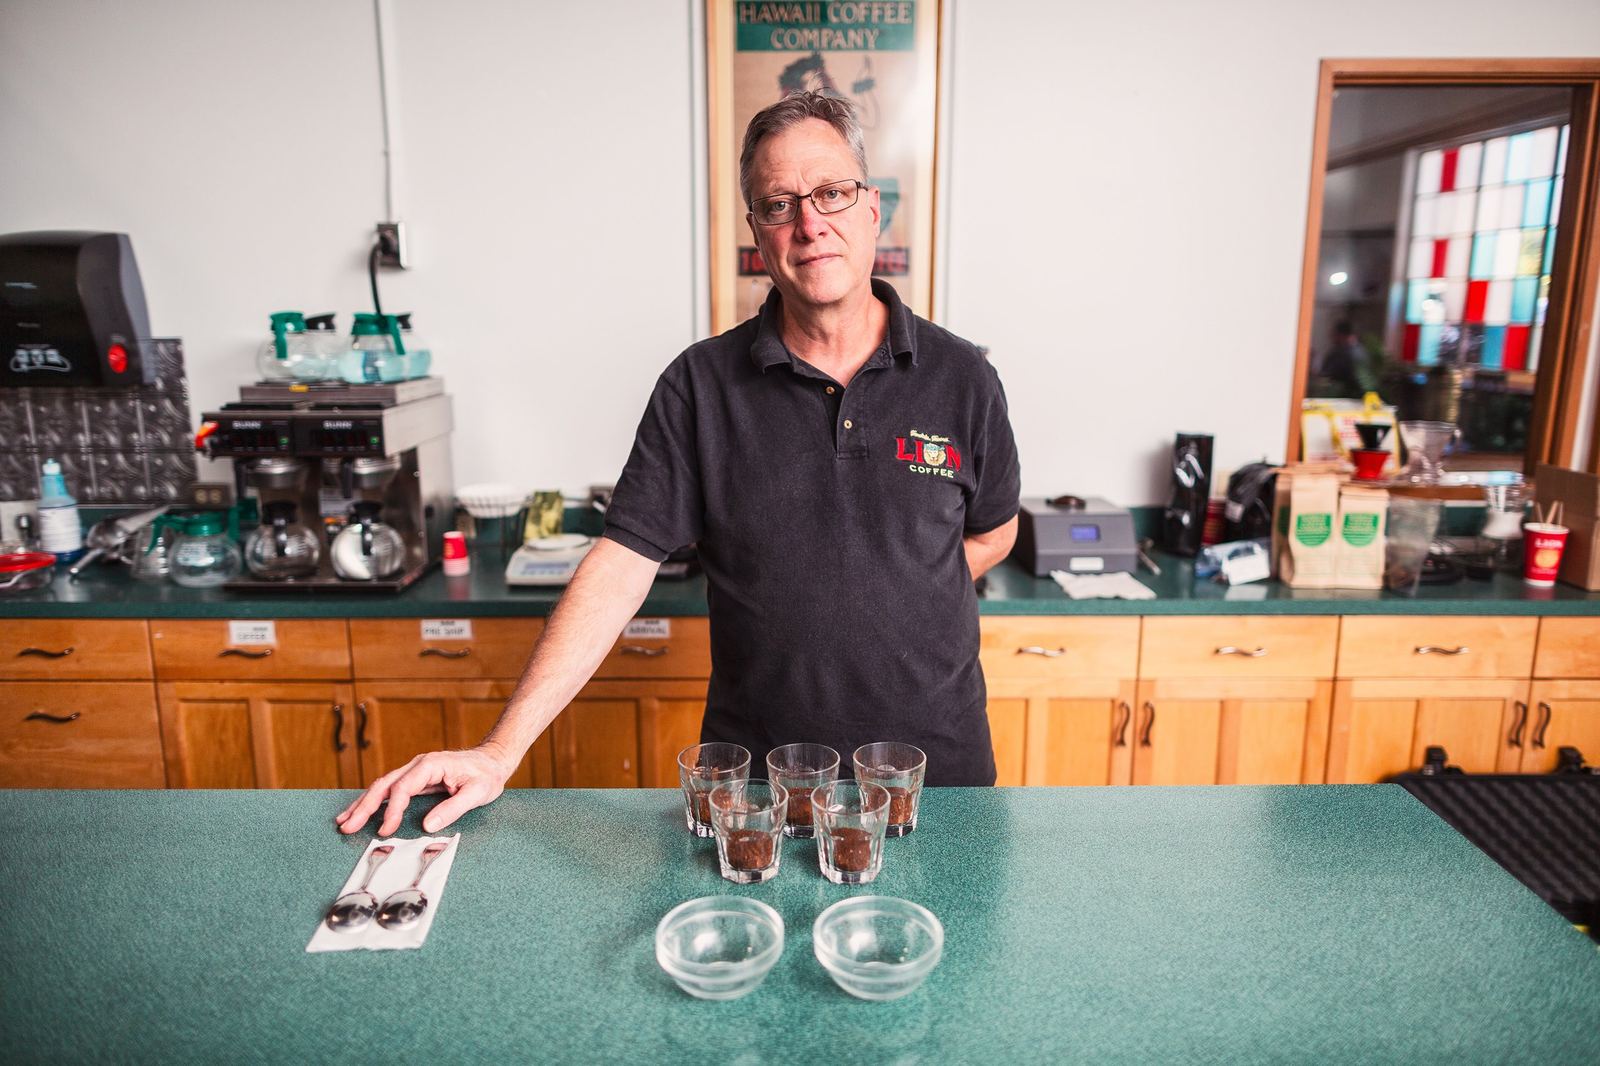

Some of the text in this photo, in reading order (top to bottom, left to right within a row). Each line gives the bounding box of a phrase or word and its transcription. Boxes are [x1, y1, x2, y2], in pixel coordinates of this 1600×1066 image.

[739, 2, 913, 24] HAWAII COFFEE
[770, 28, 880, 49] COMPANY
[909, 464, 954, 479] COFFEE
